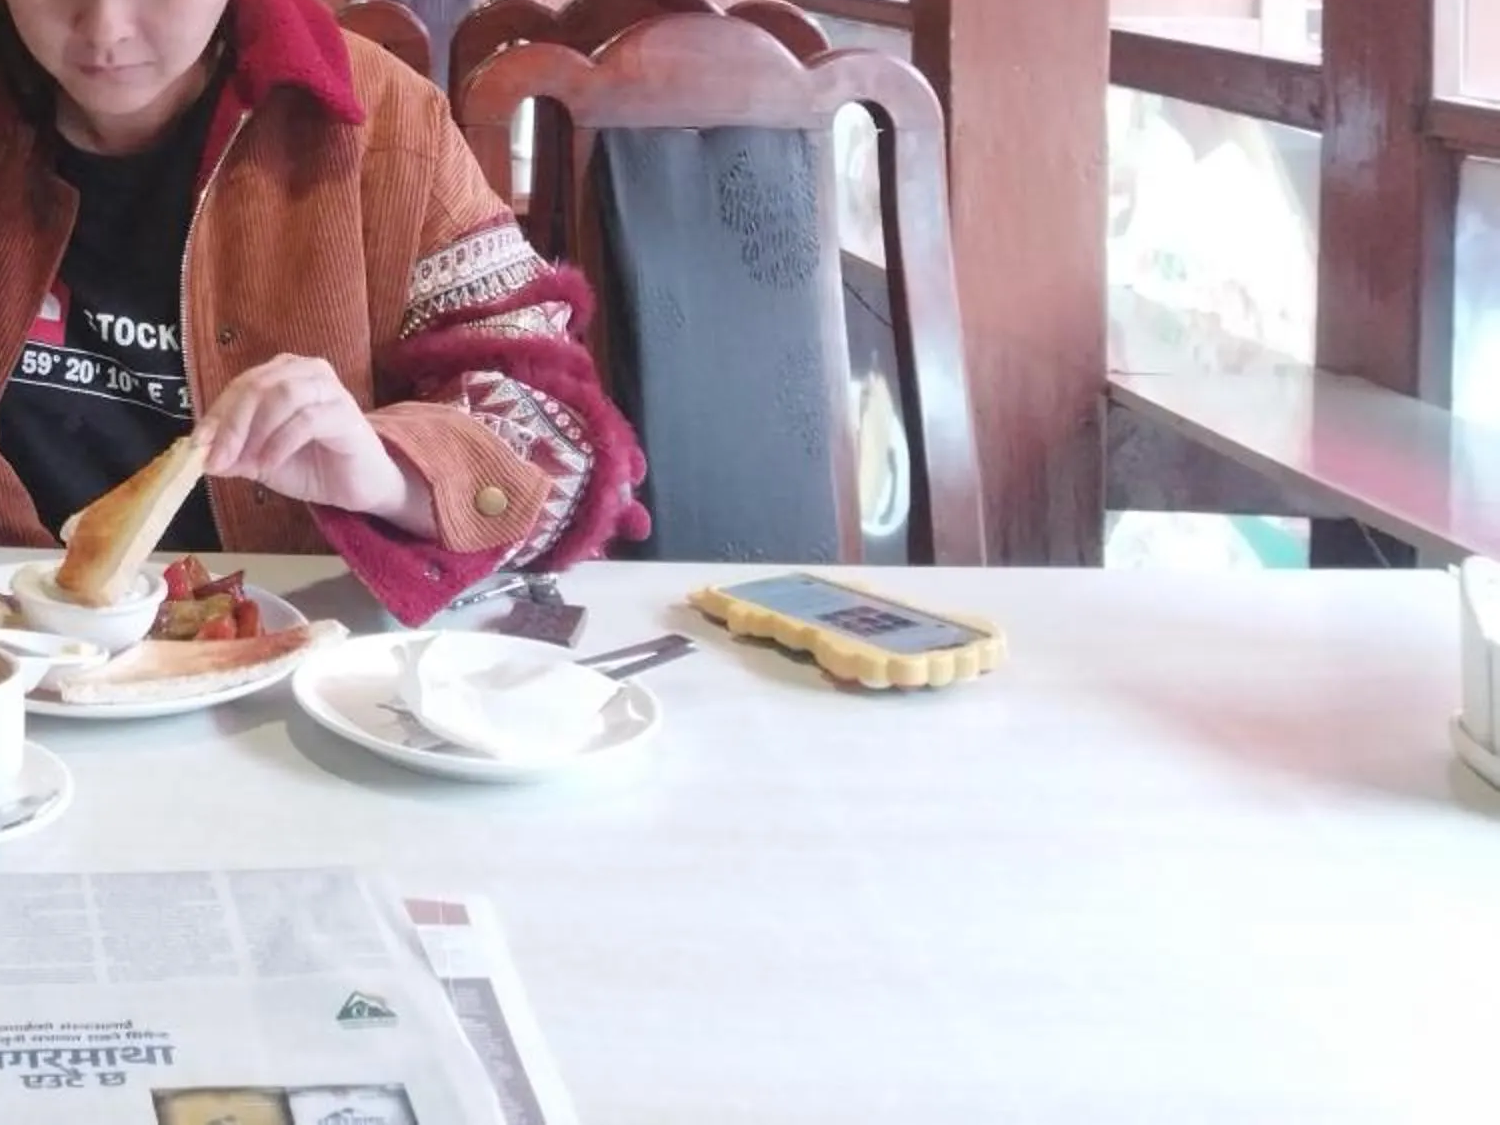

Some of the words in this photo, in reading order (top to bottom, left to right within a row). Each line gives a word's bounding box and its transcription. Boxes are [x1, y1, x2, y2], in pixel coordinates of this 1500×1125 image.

[21, 350, 61, 375] 59°
[147, 382, 164, 404] E
[96, 1072, 127, 1087] छ
